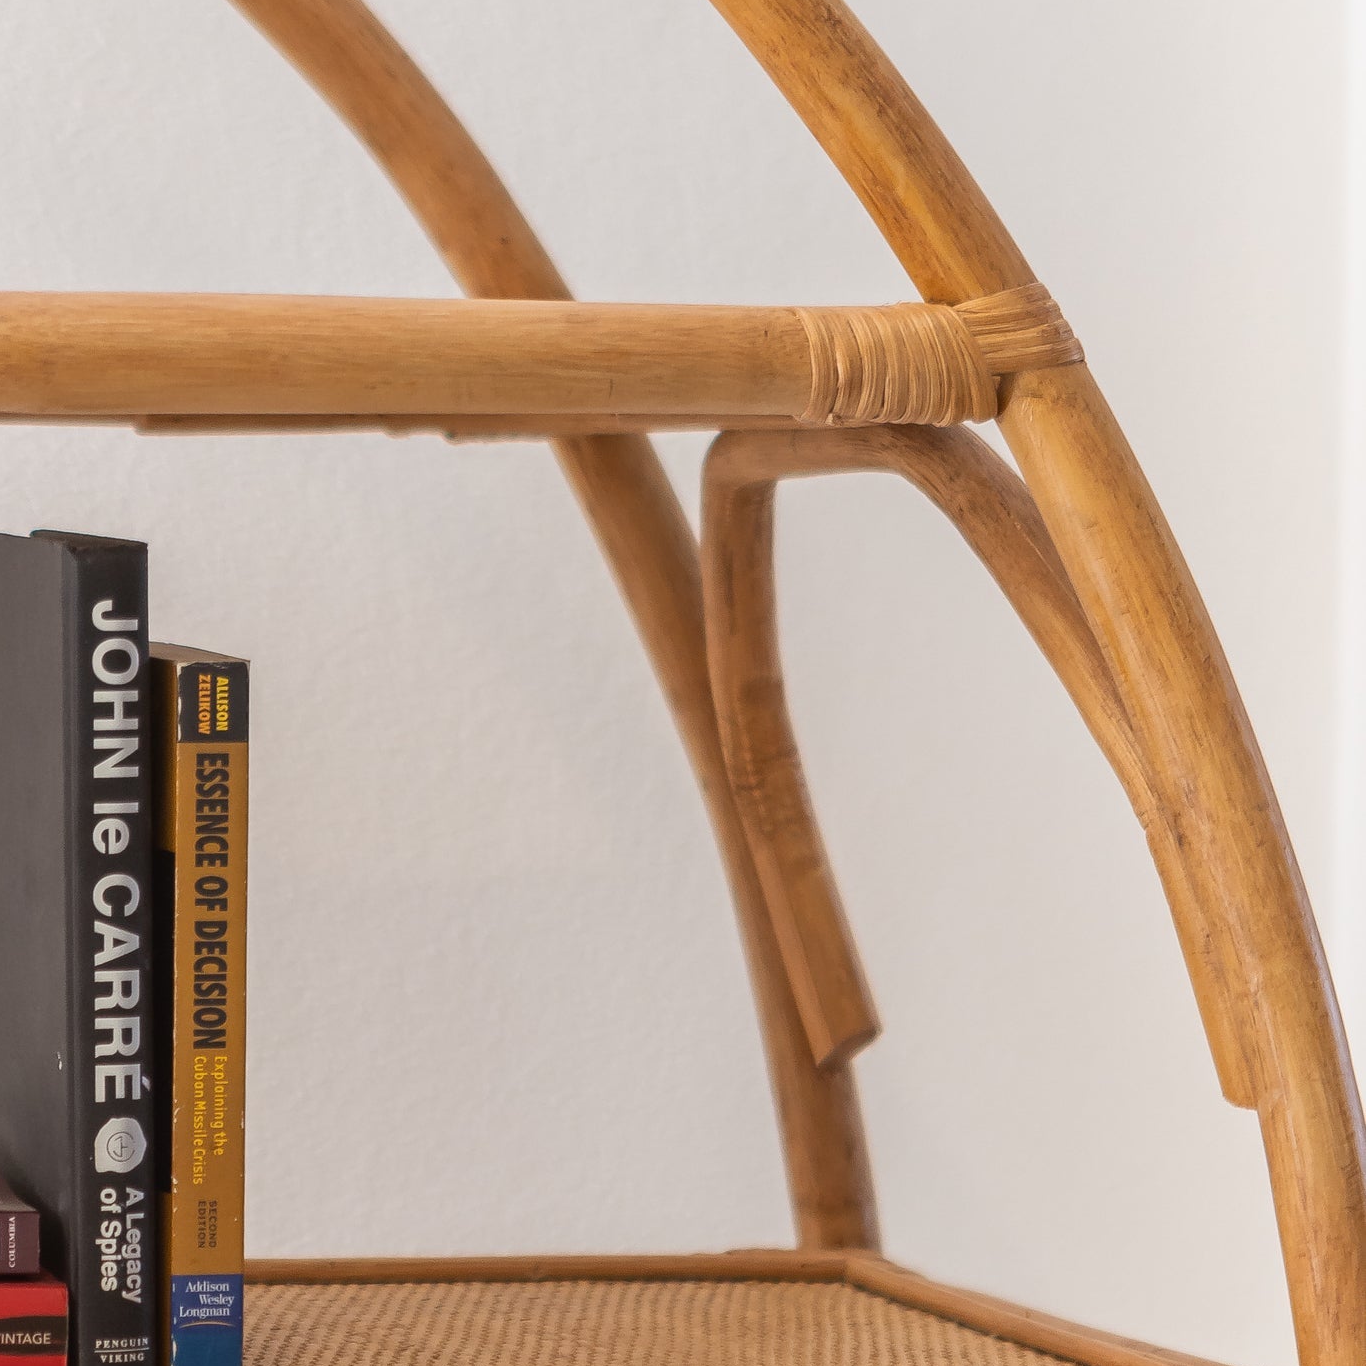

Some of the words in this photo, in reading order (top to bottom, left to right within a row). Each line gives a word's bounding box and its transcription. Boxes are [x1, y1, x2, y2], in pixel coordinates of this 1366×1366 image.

[91, 599, 140, 778] JOHN
[198, 674, 211, 734] ZELIKOW
[216, 676, 229, 731] ALLISON
[92, 802, 140, 855] le
[195, 752, 229, 868] ESSENCE
[194, 874, 228, 912] OF
[92, 873, 151, 1103] CARRÉ
[193, 919, 228, 1049] DECISION
[194, 1056, 207, 1097] Cuban
[210, 1056, 229, 1128] Explaining
[194, 1100, 207, 1146] Missile
[214, 1131, 227, 1156] the
[193, 1148, 206, 1185] Crisis
[100, 1188, 121, 1213] of
[125, 1187, 145, 1206] A
[8, 1216, 16, 1268] COLUMBIA
[198, 1200, 206, 1248] EDITION
[209, 1200, 217, 1248] SECOND
[95, 1220, 122, 1292] Spies
[122, 1212, 145, 1304] Legacy
[185, 1281, 230, 1293] Addison
[199, 1294, 235, 1307] Wesley
[179, 1306, 230, 1319] Longman
[95, 1337, 149, 1350] PENGUIN
[100, 1351, 145, 1364] VIKING
